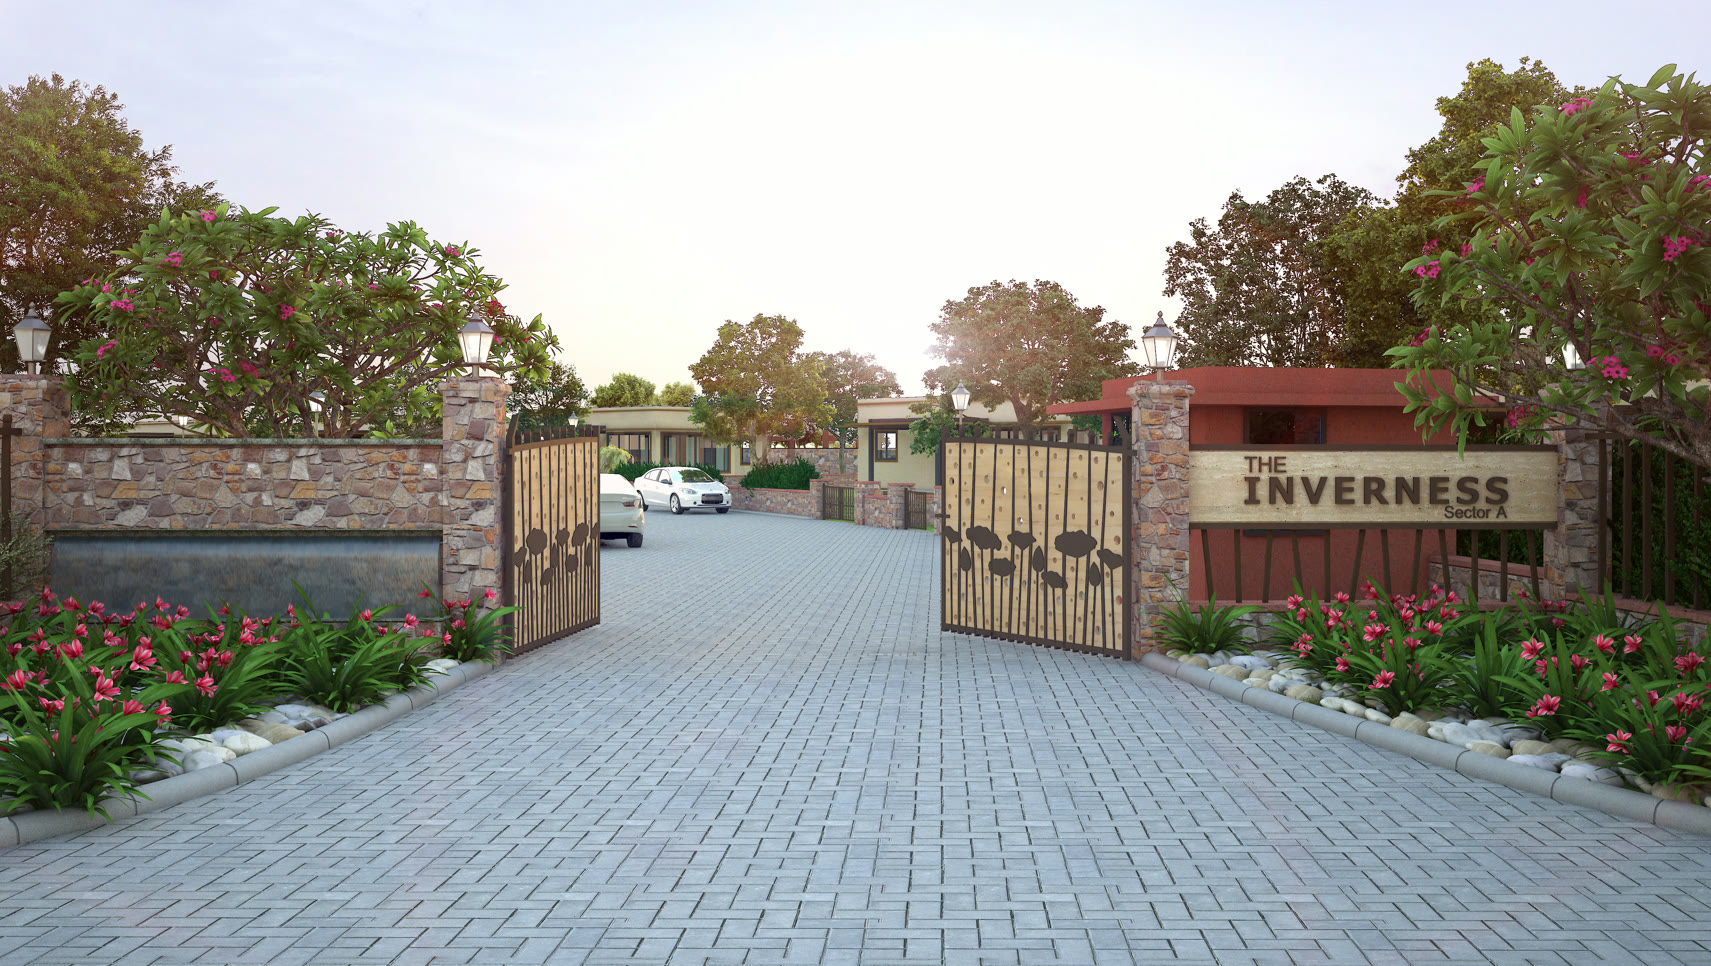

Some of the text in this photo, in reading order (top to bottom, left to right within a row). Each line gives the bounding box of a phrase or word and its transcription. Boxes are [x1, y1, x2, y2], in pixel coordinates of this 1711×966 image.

[1244, 456, 1287, 473] THE
[1244, 476, 1509, 505] INVERNESS
[1444, 505, 1508, 519] Sector A
